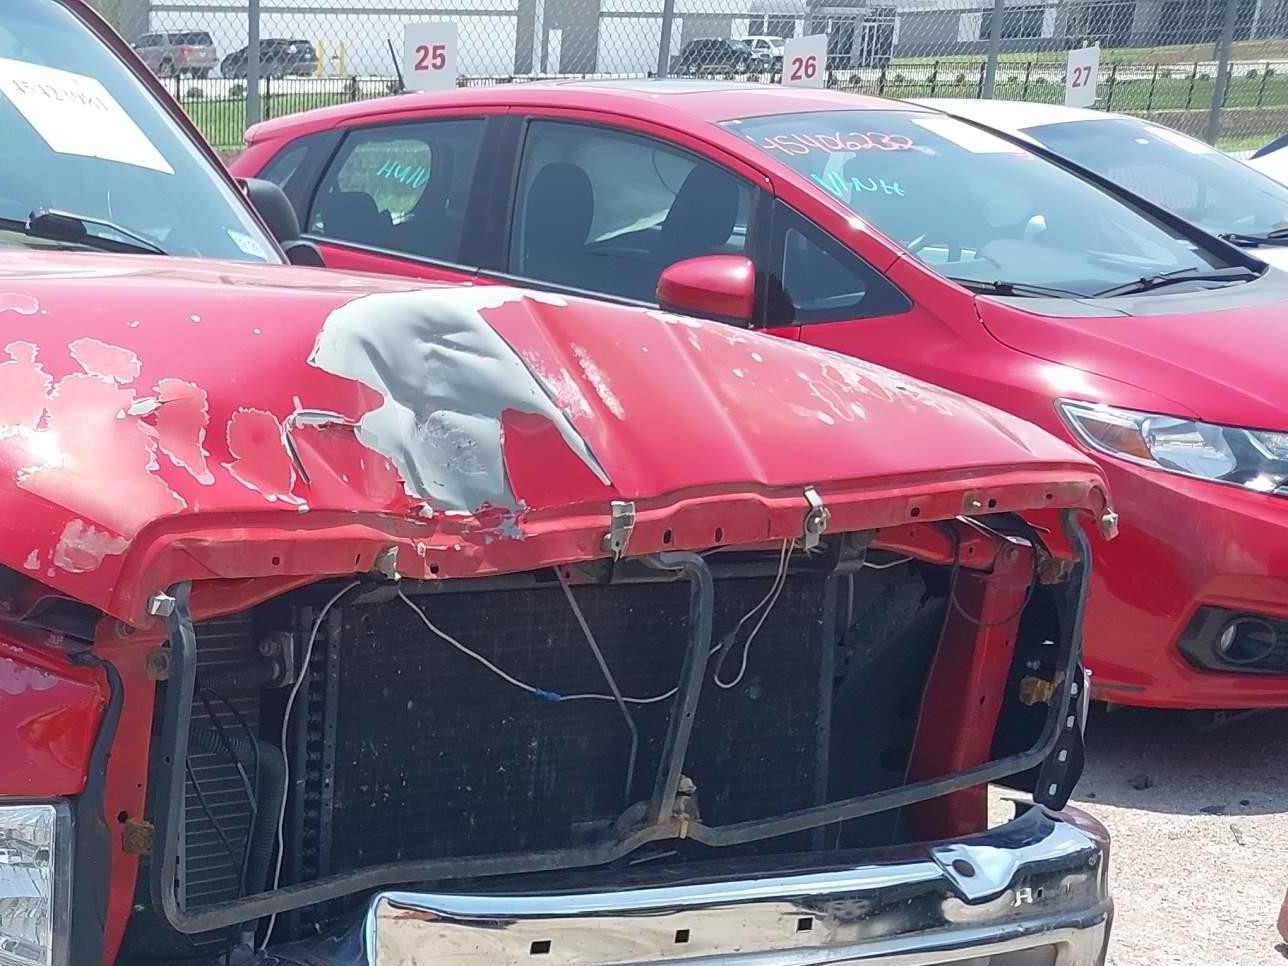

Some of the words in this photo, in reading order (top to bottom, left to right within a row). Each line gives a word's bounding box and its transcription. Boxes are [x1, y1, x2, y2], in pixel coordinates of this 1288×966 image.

[414, 45, 446, 71] 25
[791, 55, 817, 81] 26
[1072, 66, 1092, 88] 27
